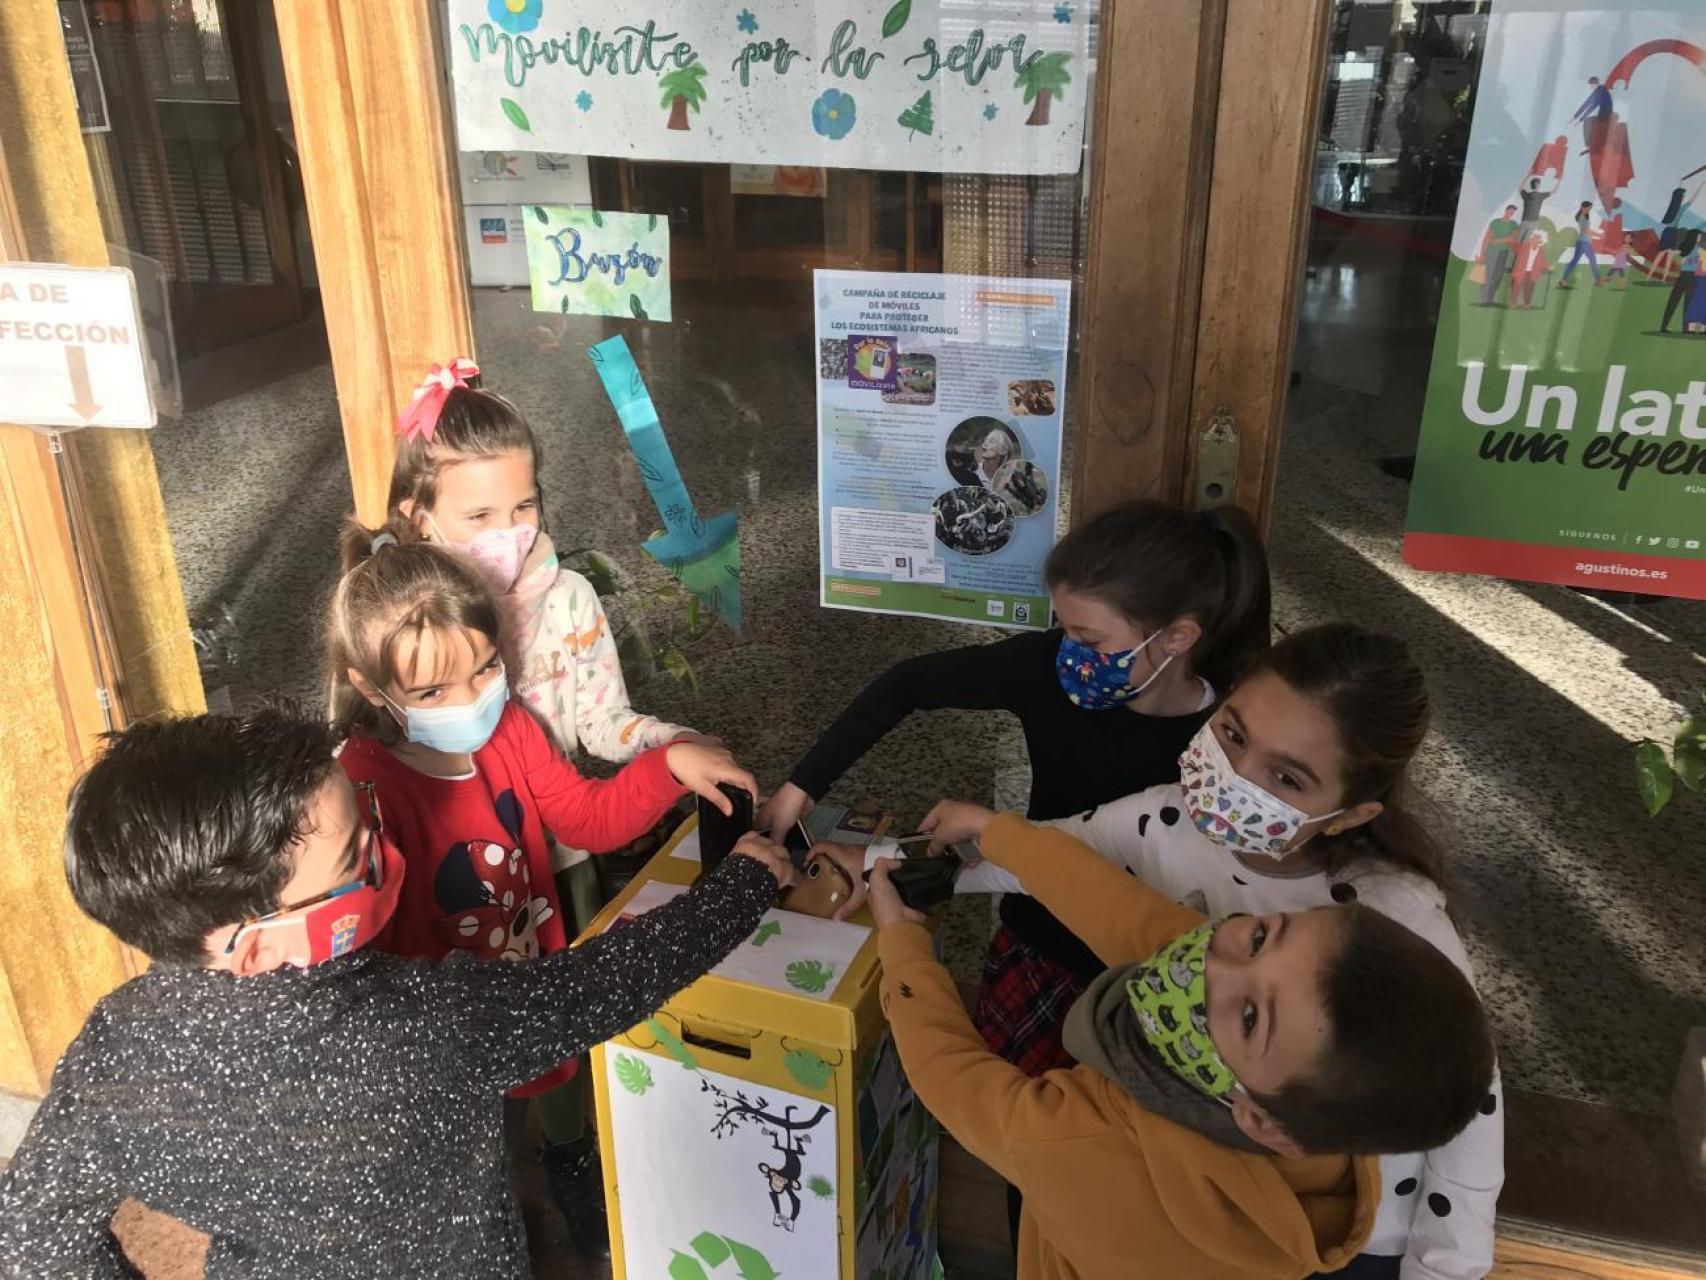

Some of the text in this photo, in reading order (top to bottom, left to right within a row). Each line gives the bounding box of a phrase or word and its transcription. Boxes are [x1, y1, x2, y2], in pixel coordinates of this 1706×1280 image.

[821, 19, 885, 79] la
[28, 282, 69, 304] DE
[843, 288, 946, 300] CAMPAÑA DE RECICLAJE
[868, 301, 921, 311] DE MÓVILES
[860, 312, 929, 323] PARA PROTEGER
[831, 322, 959, 335] LOS ECOSISTEMAS AFRICANOS
[1462, 361, 1578, 431] Un
[1478, 430, 1570, 466] una
[1575, 562, 1668, 580] agustinos.es
